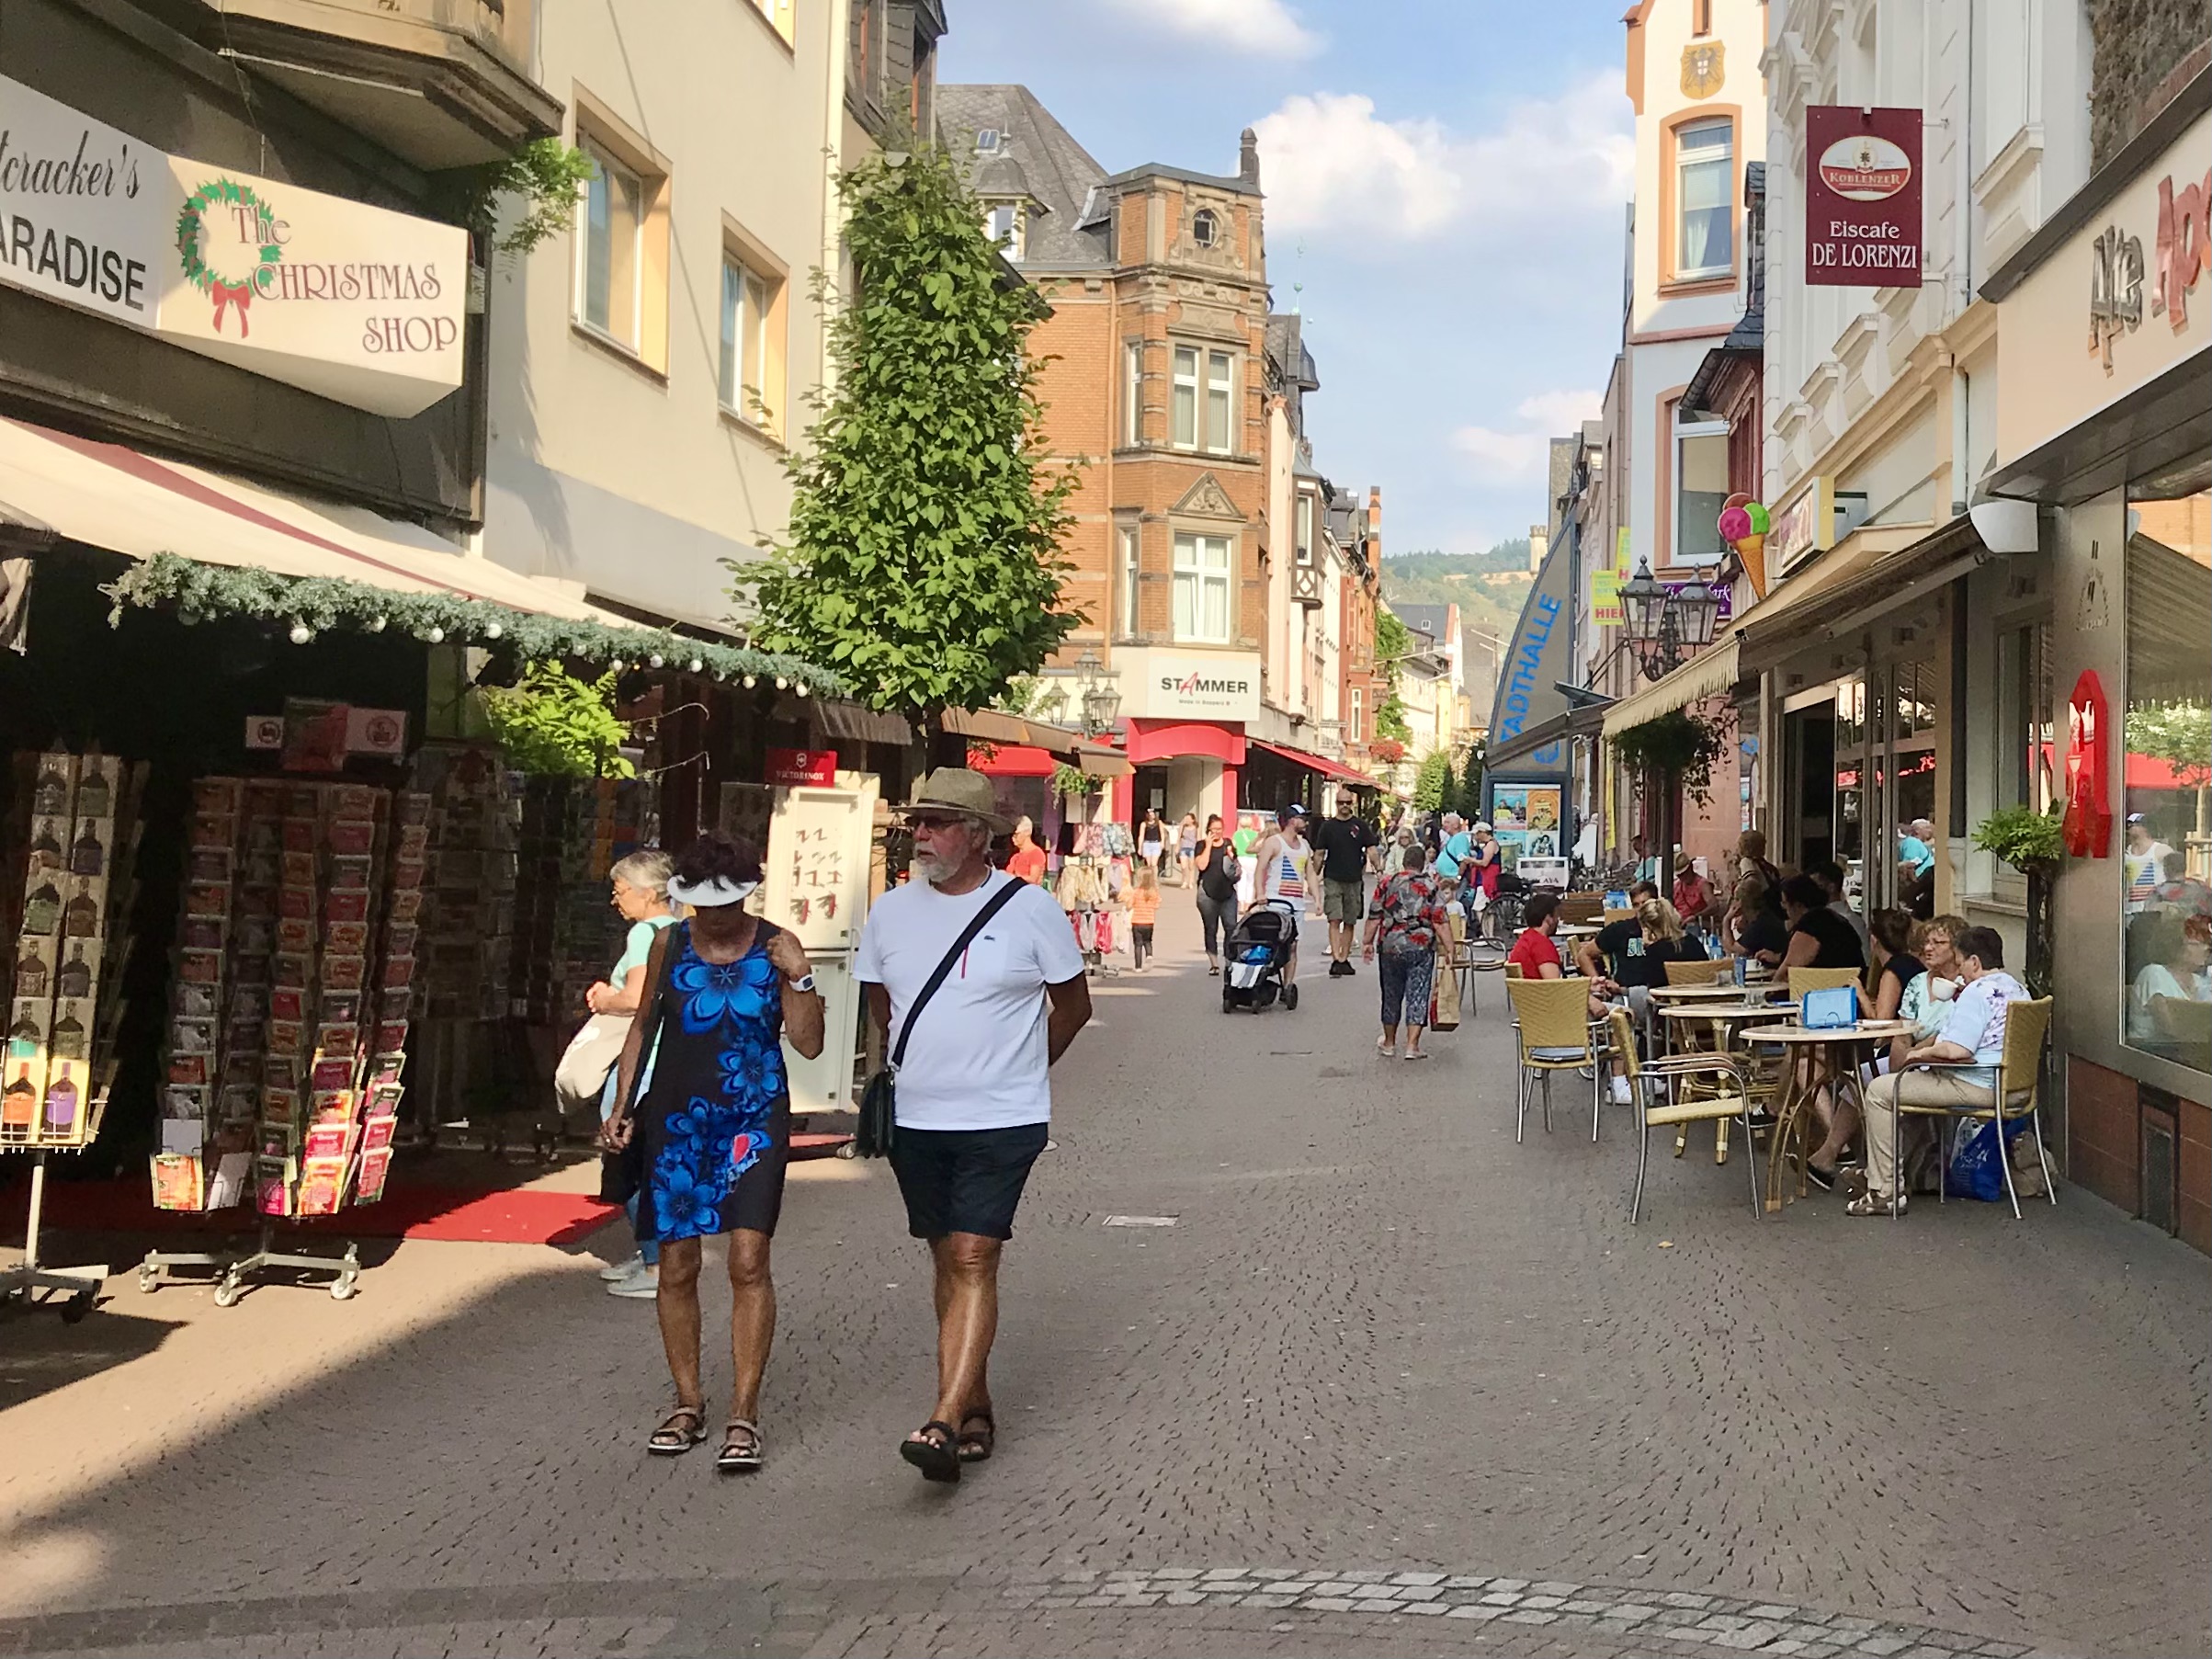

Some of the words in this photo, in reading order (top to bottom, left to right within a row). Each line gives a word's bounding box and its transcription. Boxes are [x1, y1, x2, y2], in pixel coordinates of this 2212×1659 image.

[232, 203, 291, 244] The
[1830, 221, 1900, 239] Eiscafe
[1811, 242, 1837, 267] DE
[1842, 244, 1918, 268] LORENZI
[252, 262, 441, 301] CHRISTMAS
[362, 315, 458, 354] SHOP
[1161, 671, 1249, 697] STAMMER
[776, 770, 825, 781] VICTORINOX
